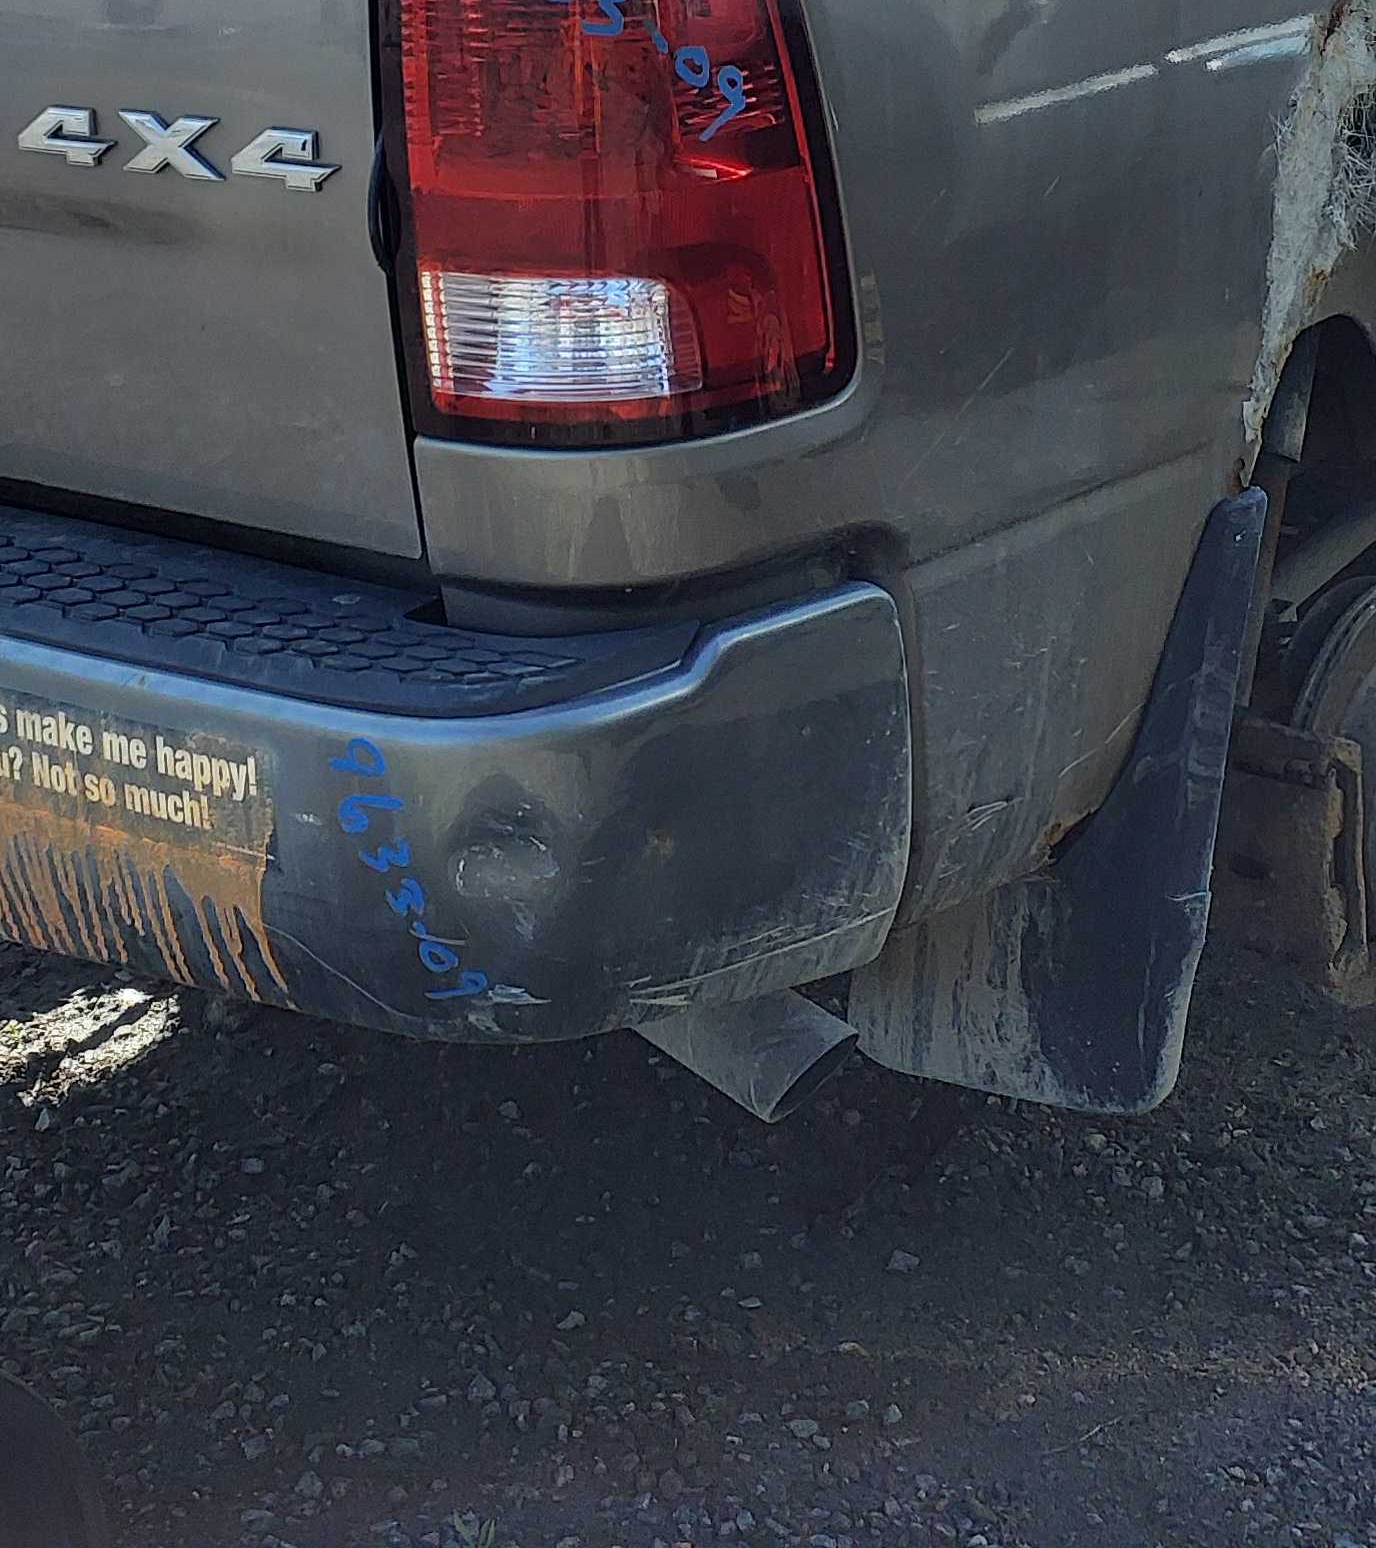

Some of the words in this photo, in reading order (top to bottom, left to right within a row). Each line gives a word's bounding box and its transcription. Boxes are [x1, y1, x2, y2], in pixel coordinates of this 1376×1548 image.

[15, 708, 94, 756] make
[102, 729, 148, 771] me
[155, 736, 259, 803] happy!
[31, 751, 79, 798] Not
[84, 772, 117, 807] so
[124, 782, 216, 830] much!
[328, 736, 491, 1002] 9633-09
